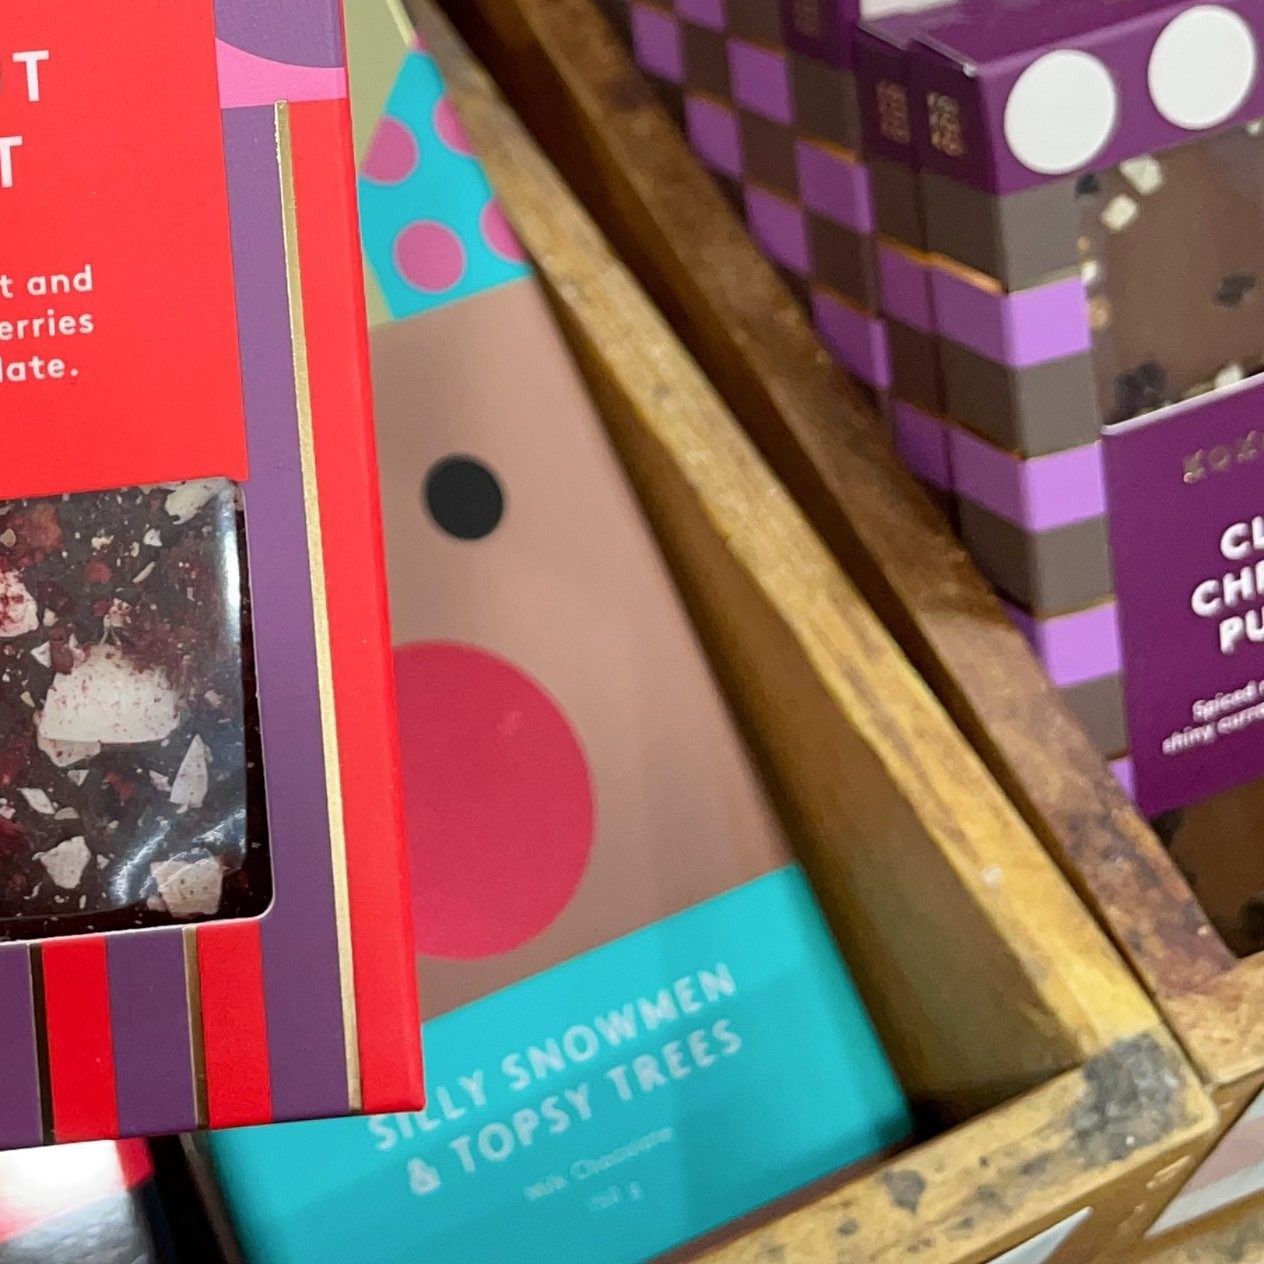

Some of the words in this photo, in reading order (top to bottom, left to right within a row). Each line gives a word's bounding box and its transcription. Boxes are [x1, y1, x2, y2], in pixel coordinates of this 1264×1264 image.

[27, 264, 94, 297] and
[367, 1070, 487, 1152] SILLY
[501, 961, 737, 1093] SNOWMEN
[407, 1157, 441, 1196] &
[448, 1082, 594, 1174] TOPSY
[606, 1018, 743, 1102] TREES
